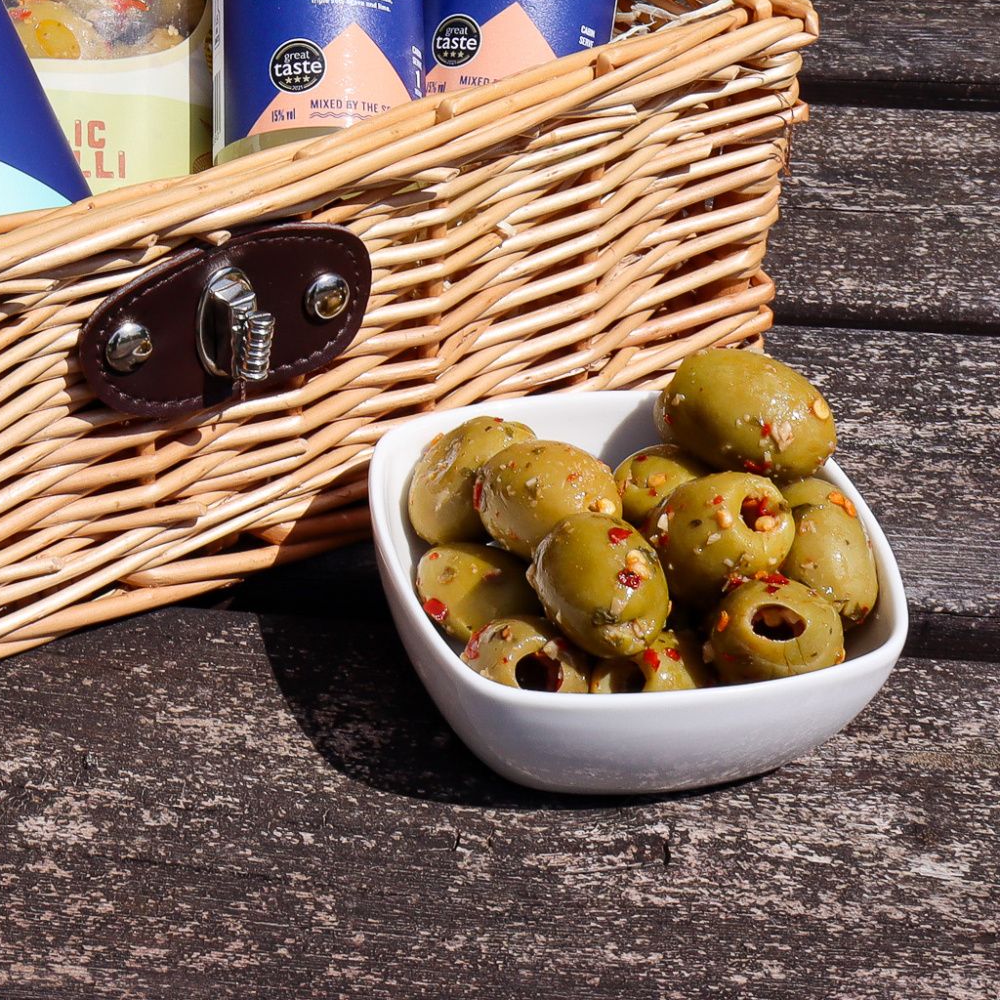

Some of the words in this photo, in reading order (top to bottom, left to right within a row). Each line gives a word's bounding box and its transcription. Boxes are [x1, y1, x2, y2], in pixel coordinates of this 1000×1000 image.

[445, 26, 468, 37] great
[436, 36, 478, 51] taste
[284, 50, 310, 63] great
[274, 60, 323, 77] taste
[310, 99, 342, 109] MIXED
[345, 100, 358, 110] BY
[361, 101, 378, 113] THE
[271, 109, 284, 123] 15%
[286, 108, 296, 120] vol
